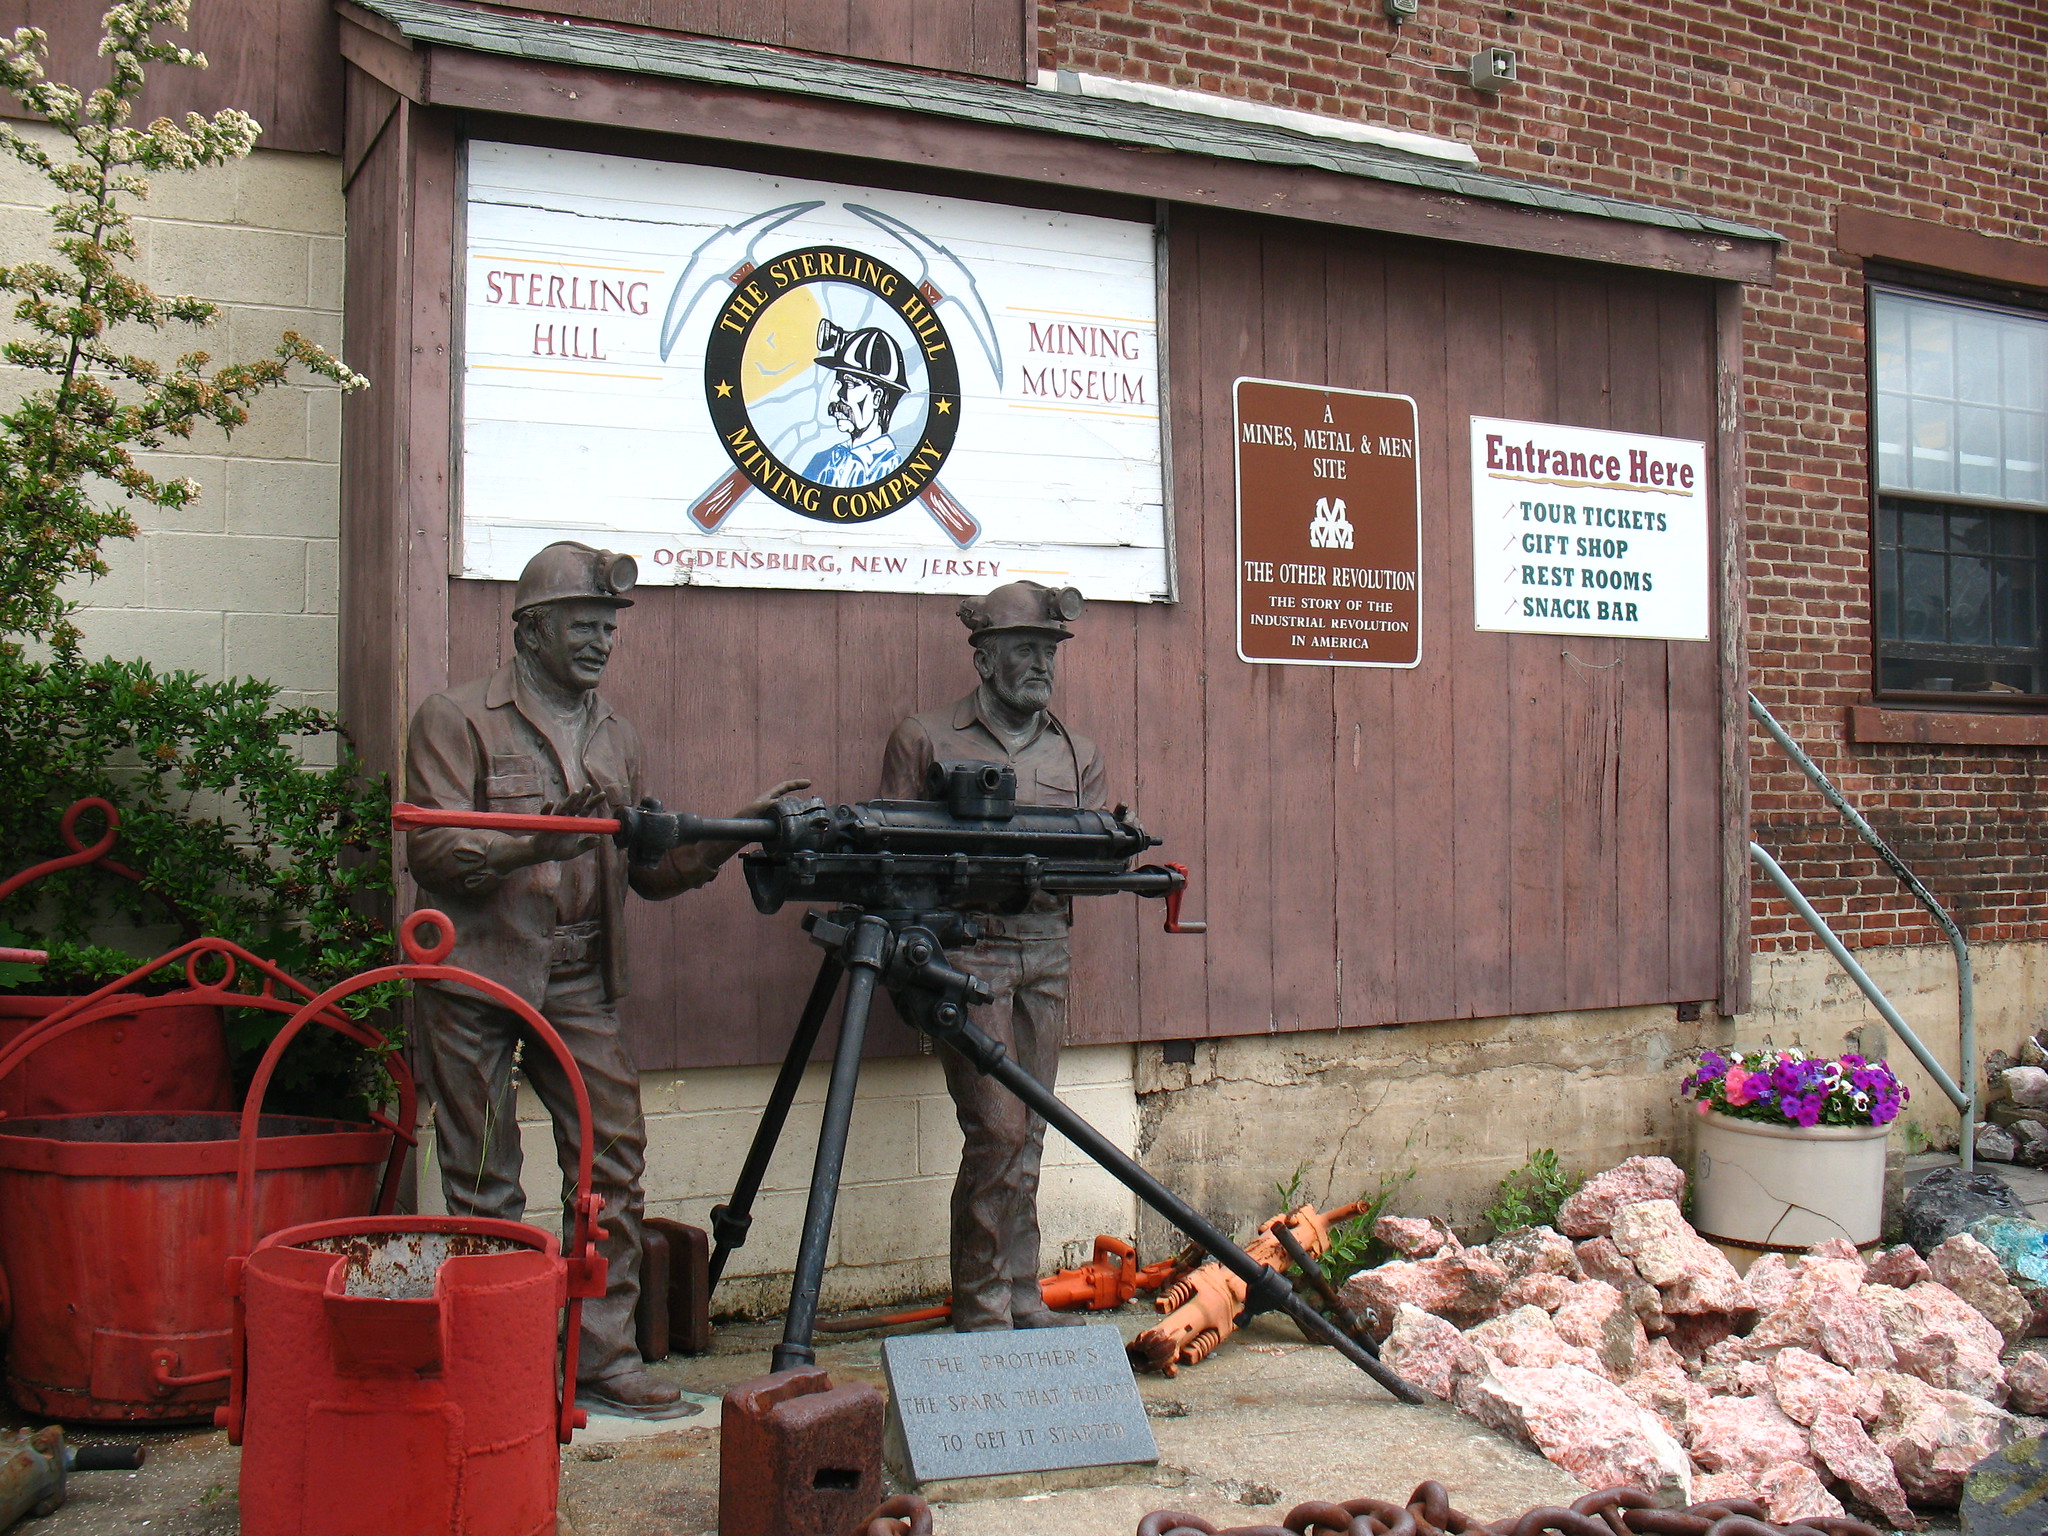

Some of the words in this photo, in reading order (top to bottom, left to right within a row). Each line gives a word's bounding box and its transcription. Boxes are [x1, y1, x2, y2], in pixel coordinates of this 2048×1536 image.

[486, 270, 648, 316] STERLING
[719, 280, 770, 335] THE
[769, 252, 899, 297] STERLING
[901, 293, 948, 361] HILL
[532, 323, 607, 361] HILL
[1028, 321, 1139, 361] MINING
[1022, 364, 1145, 405] MUSEUM
[1323, 404, 1334, 424] A
[1242, 422, 1297, 451] MINES,
[1303, 429, 1355, 453] METAL
[1361, 434, 1372, 454] &
[1378, 436, 1412, 458] MEN
[725, 425, 821, 512] MINING
[832, 438, 943, 518] COMPANY
[1312, 457, 1347, 480] SITE
[1485, 433, 1621, 482] Entrance
[1629, 449, 1694, 489] Here
[1520, 501, 1577, 525] TOUR
[1582, 506, 1668, 532] TICKETS
[1521, 533, 1569, 555] GIFT
[1577, 537, 1629, 559] SHOP
[653, 548, 842, 576] OGDENSBURG,
[850, 555, 908, 574] NEW
[921, 558, 1001, 579] JERSEY
[1244, 560, 1274, 583] THE
[1279, 563, 1327, 586] OTHER
[1332, 567, 1415, 591] REVOLUTION
[1521, 565, 1575, 587] REST
[1581, 568, 1653, 592] ROOMS
[1268, 595, 1296, 609] THE
[1301, 597, 1341, 610] STORY
[1346, 599, 1363, 611] OF
[1367, 600, 1393, 613] THE
[1523, 596, 1591, 620] SNACK
[1597, 600, 1639, 622] BAR
[1250, 613, 1326, 629] INDUSTRIAL
[1330, 618, 1409, 632] REVOLUTION
[1291, 635, 1306, 647] IN
[1311, 636, 1369, 649] AMERICA
[920, 1356, 965, 1373] THE
[980, 1347, 1099, 1371] BROTHER'S
[903, 1397, 938, 1415] THE
[949, 1392, 1008, 1412] SPARK
[1014, 1388, 1059, 1407] THAT
[938, 1433, 963, 1452] TO
[975, 1430, 1006, 1449] GET
[1018, 1428, 1036, 1447] IT
[1049, 1422, 1125, 1444] STARTED
